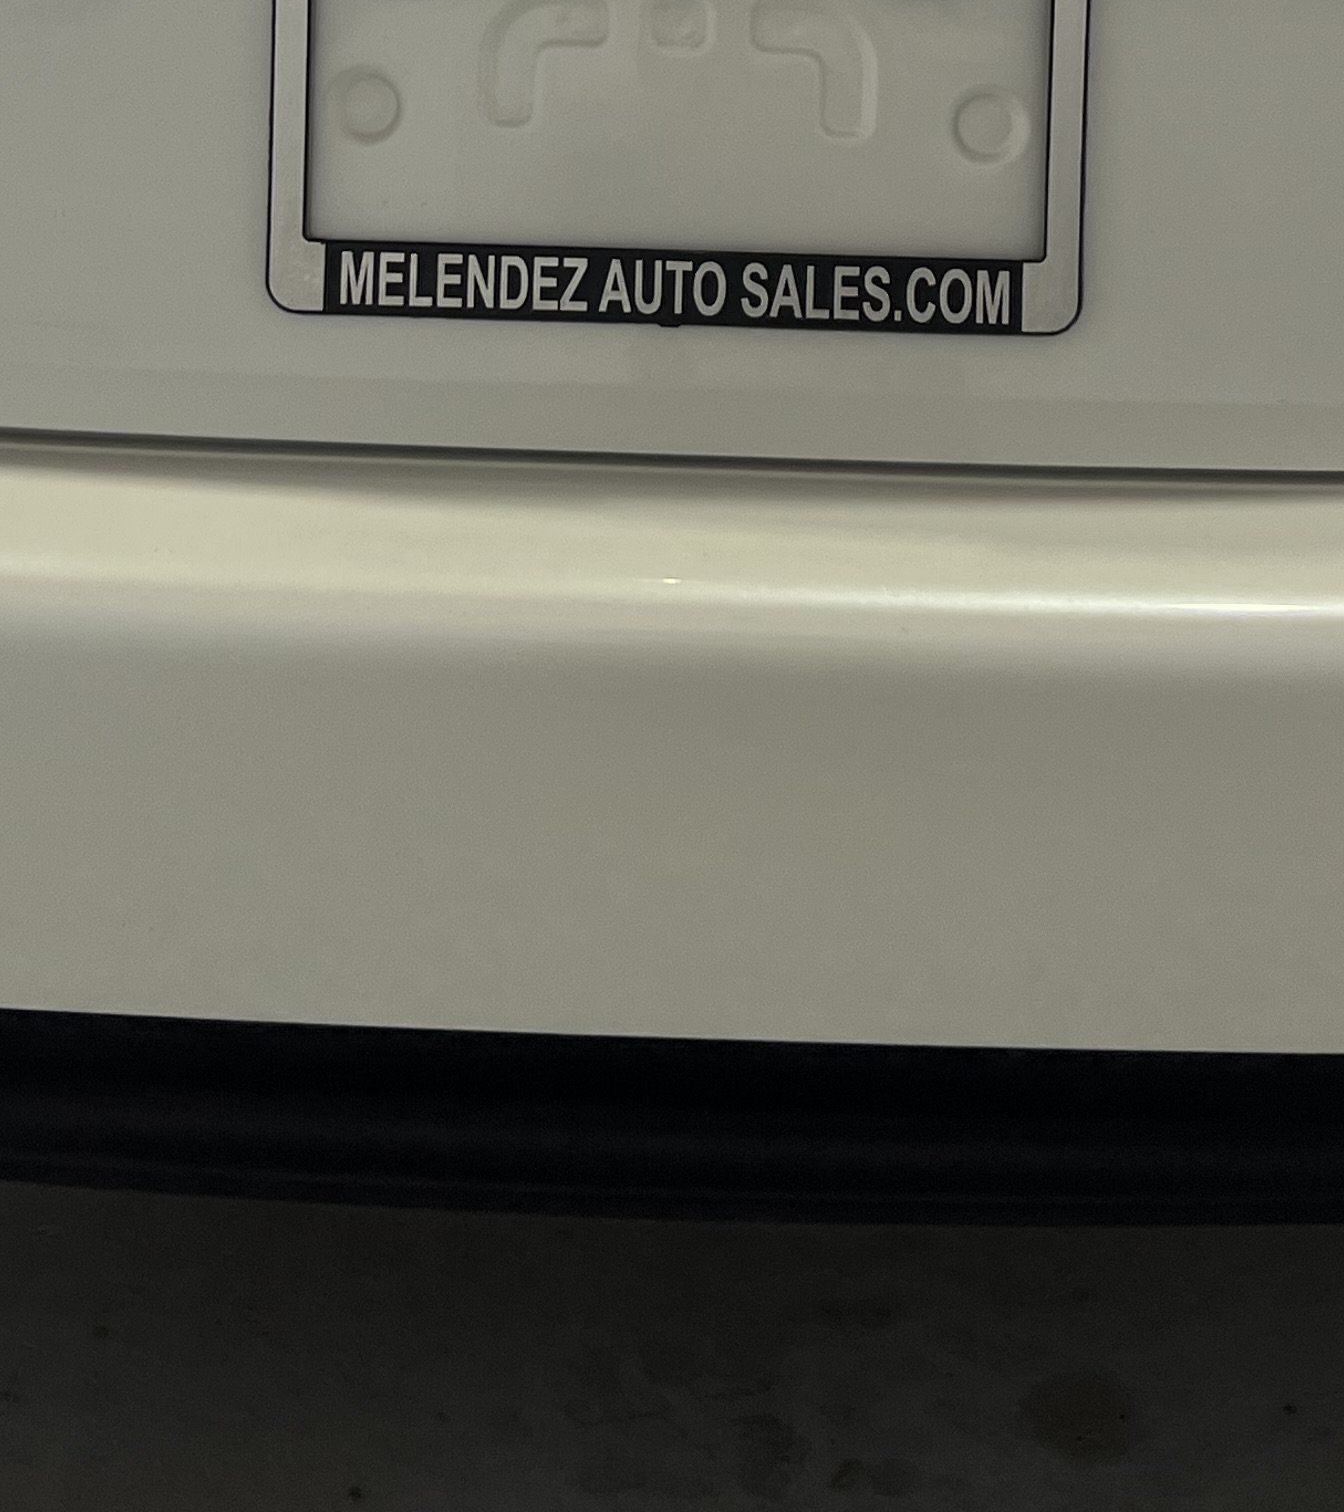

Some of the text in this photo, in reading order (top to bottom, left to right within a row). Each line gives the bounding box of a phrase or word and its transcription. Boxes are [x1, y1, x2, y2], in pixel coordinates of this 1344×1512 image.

[339, 249, 1011, 326] MELENDEZ AUTO SALES.COM
